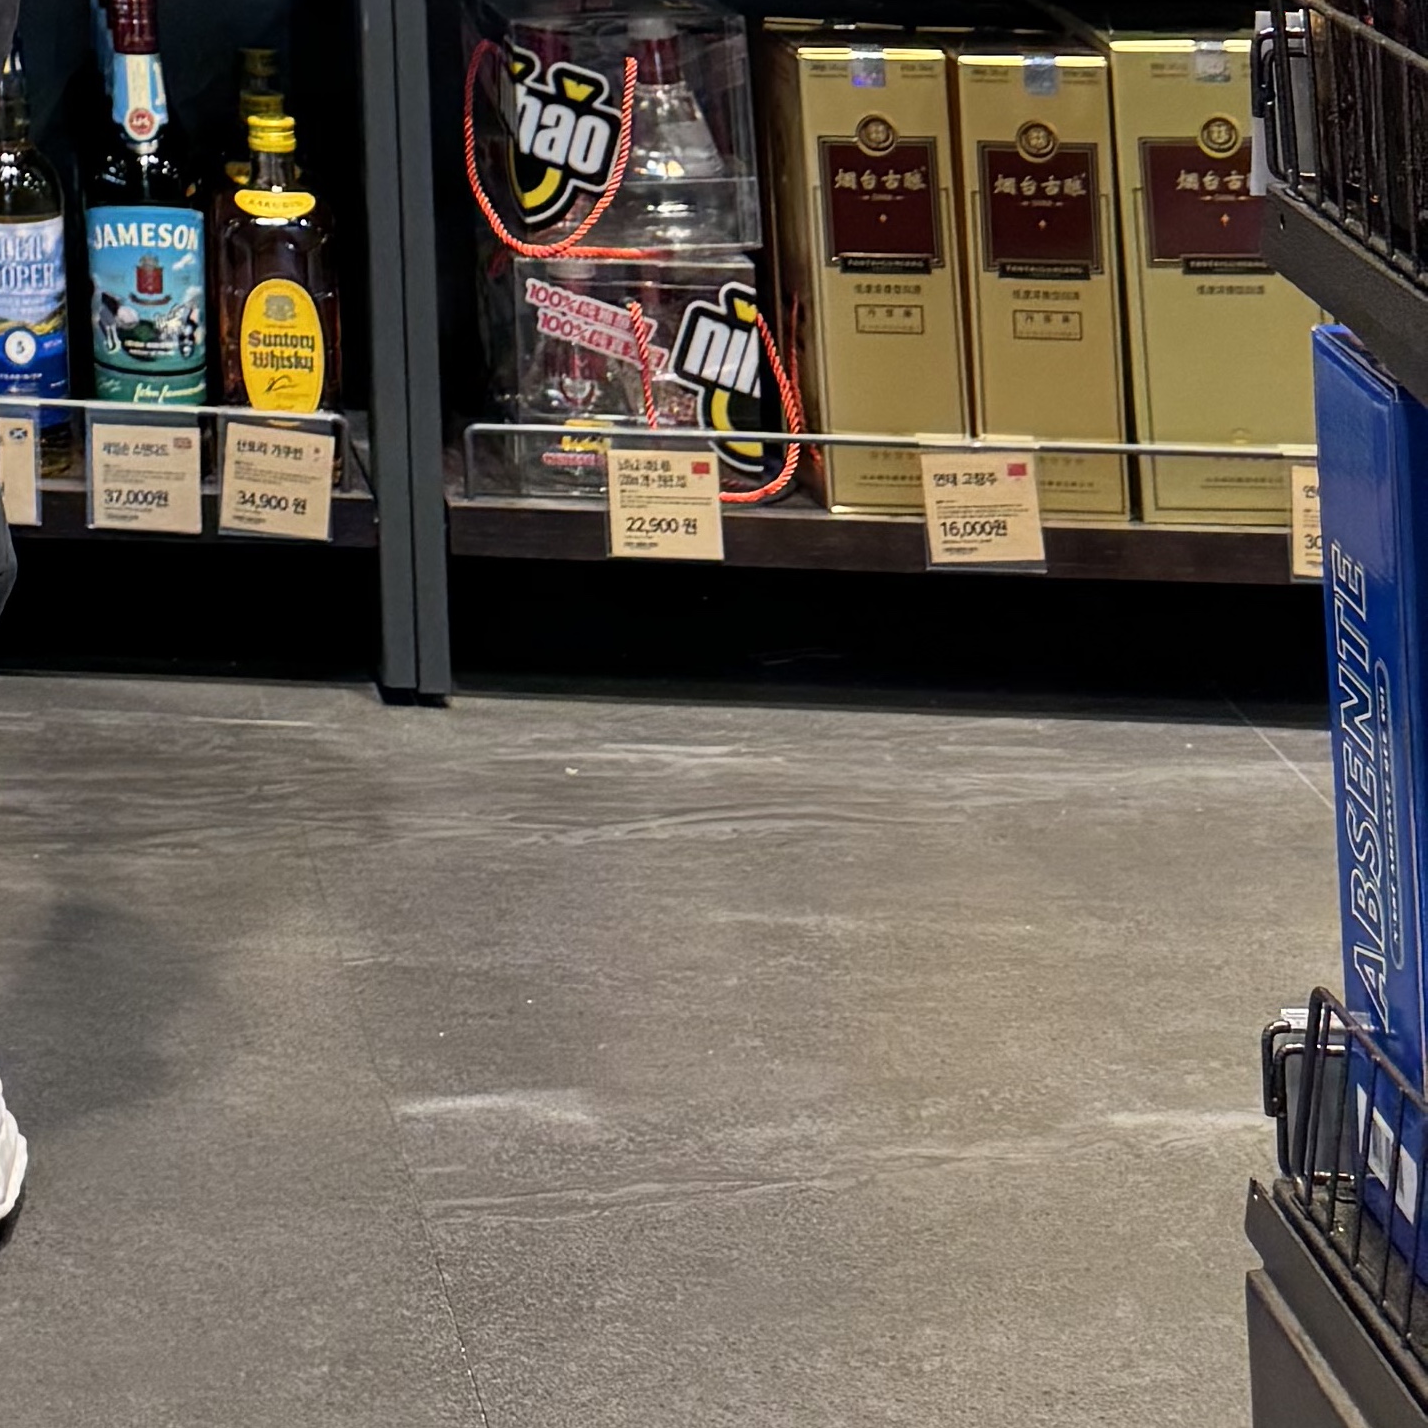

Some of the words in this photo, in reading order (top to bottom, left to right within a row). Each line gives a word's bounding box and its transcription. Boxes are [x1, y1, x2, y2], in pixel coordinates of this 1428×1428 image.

[93, 222, 199, 250] JAMESON
[247, 330, 316, 354] Suntory
[250, 350, 315, 374] Whisky
[103, 489, 170, 507] 37,000원
[1332, 539, 1393, 1035] ABSENTE
